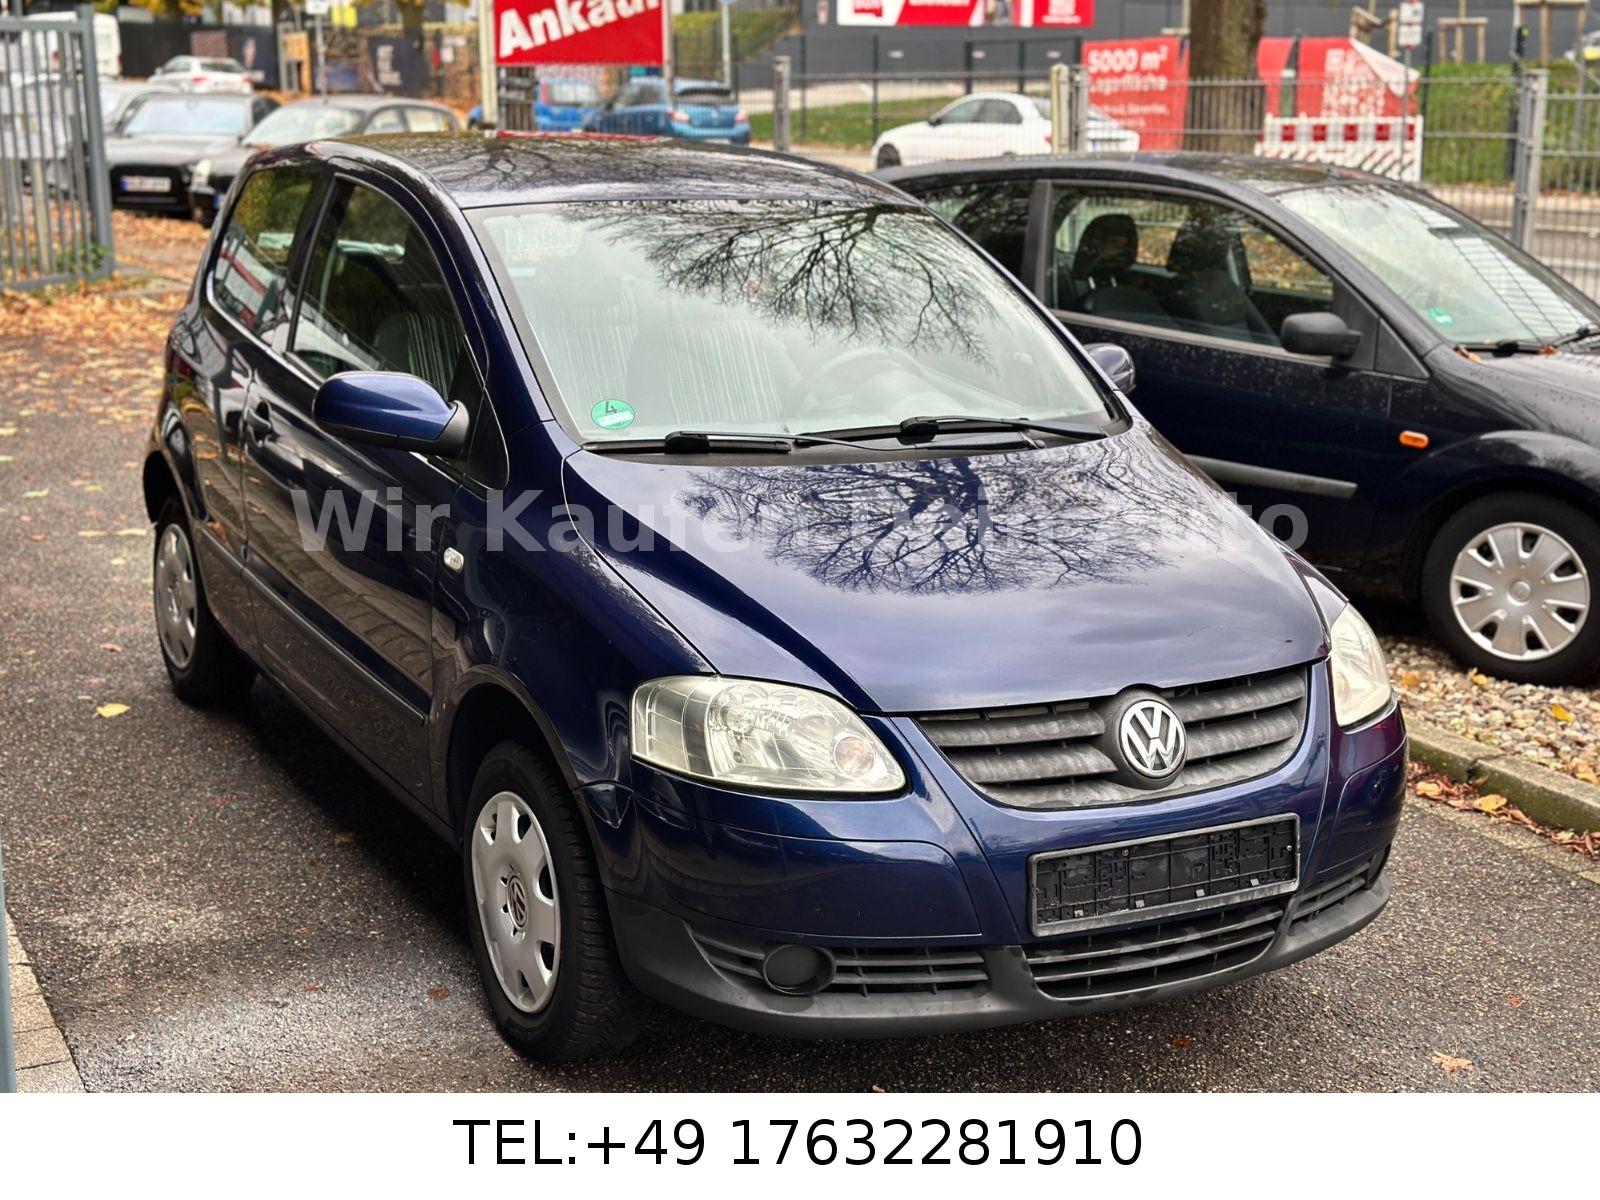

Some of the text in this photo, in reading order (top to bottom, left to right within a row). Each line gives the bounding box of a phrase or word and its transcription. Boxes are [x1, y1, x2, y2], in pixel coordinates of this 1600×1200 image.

[499, 0, 660, 58] Ankau
[1088, 48, 1138, 74] 5000
[605, 401, 618, 414] 4
[1120, 700, 1187, 778] VW
